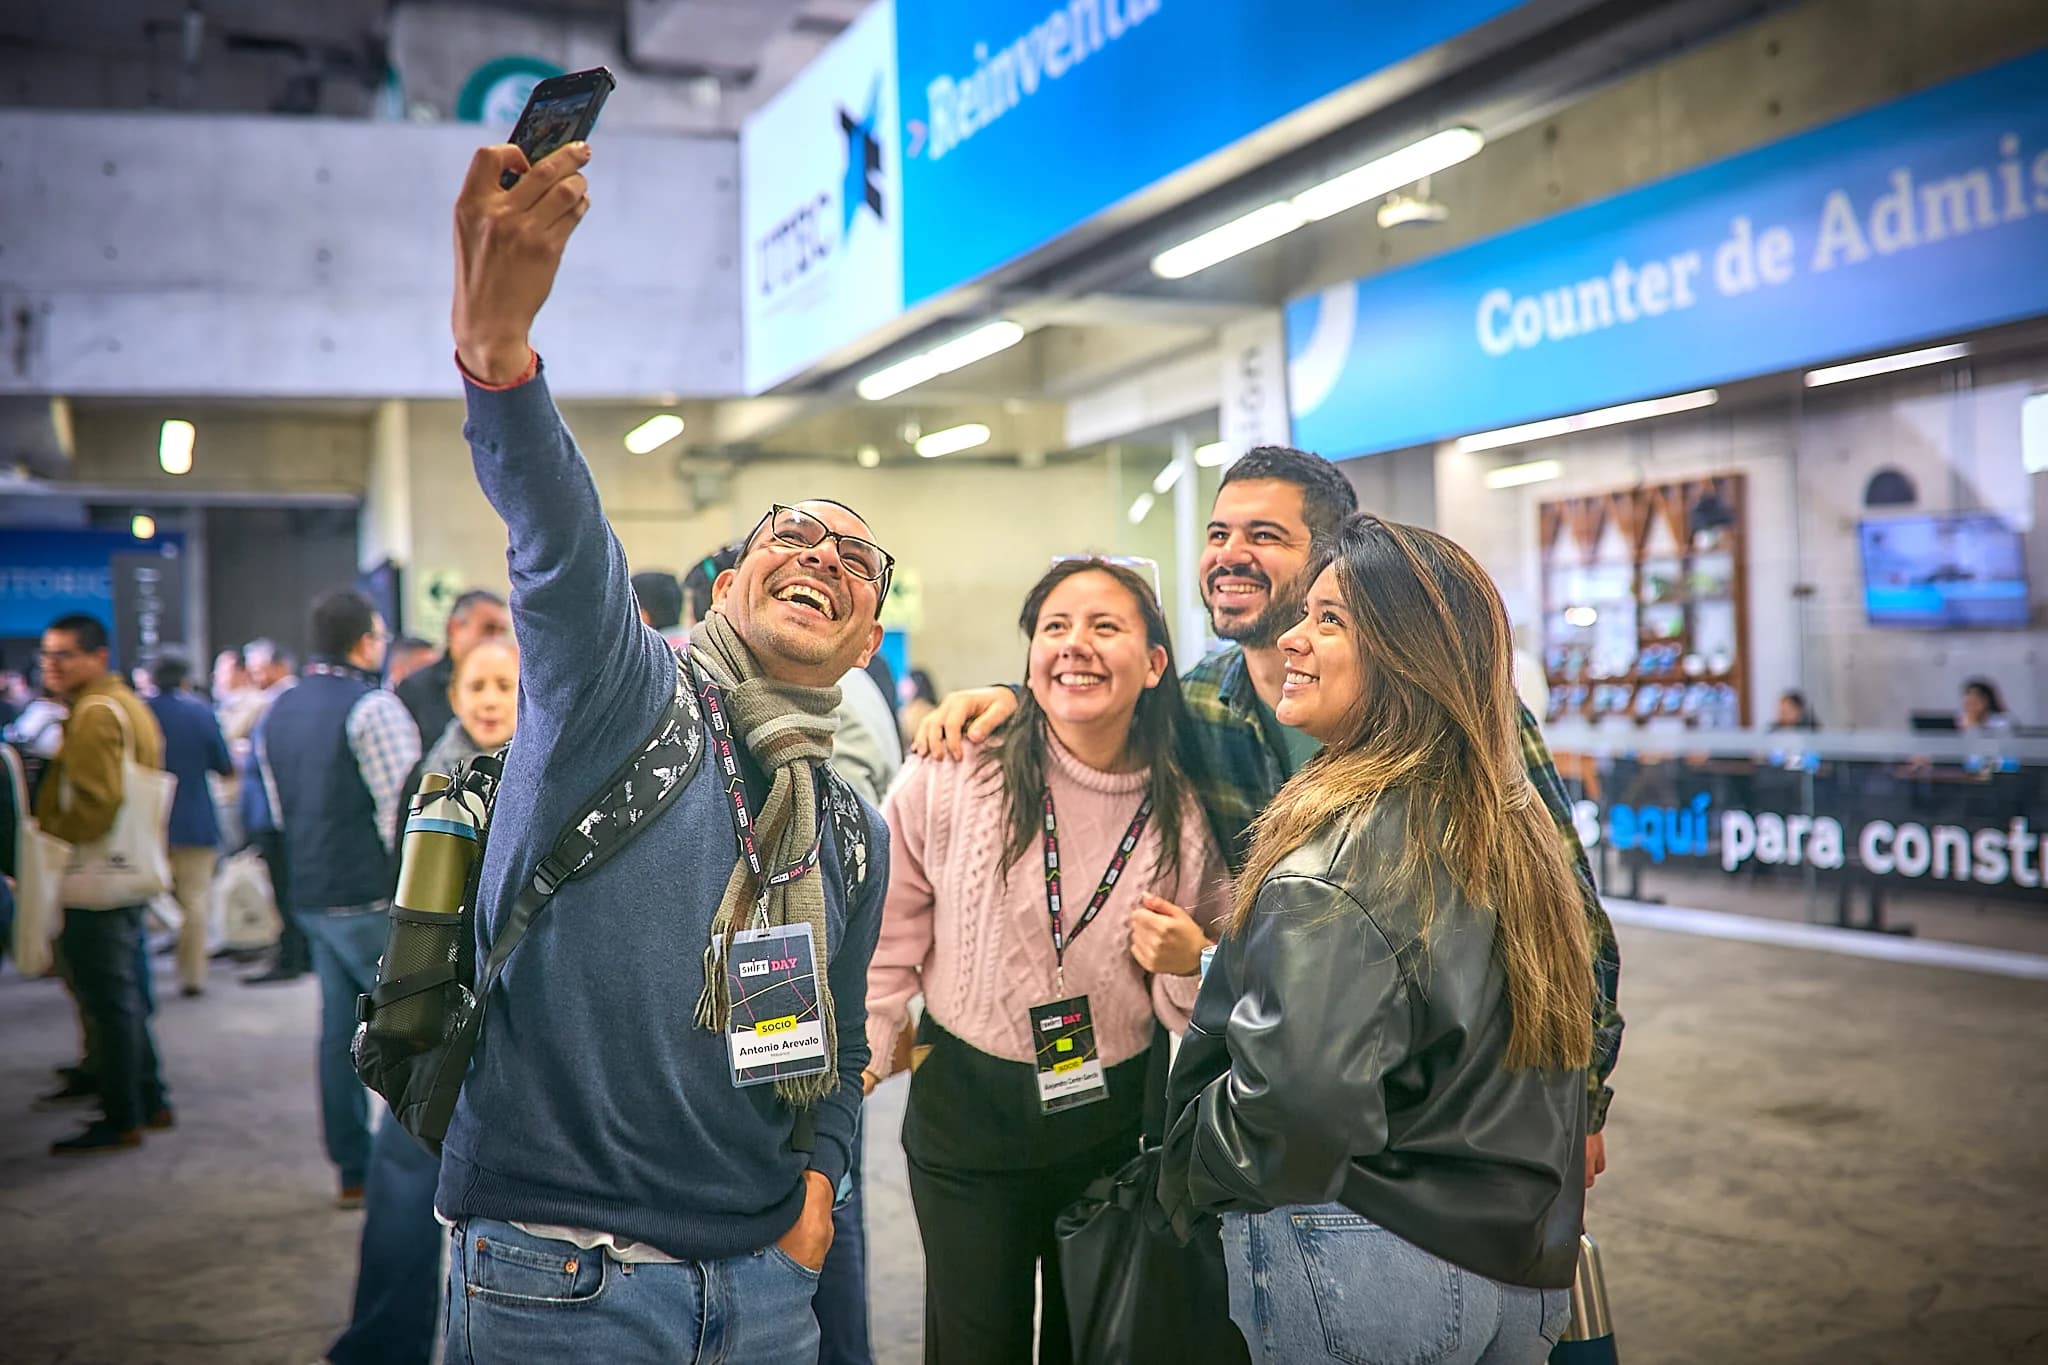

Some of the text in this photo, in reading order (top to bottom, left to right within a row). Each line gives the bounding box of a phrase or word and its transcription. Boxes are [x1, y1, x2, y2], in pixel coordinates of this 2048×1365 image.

[1476, 251, 1702, 356] Counter
[1714, 216, 1797, 297] de
[1721, 810, 1845, 873] para
[790, 866, 804, 878] DAY
[740, 957, 798, 975] SHIFT DAY
[762, 1020, 792, 1032] SOCIO
[739, 1042, 779, 1057] Antonio
[782, 1036, 819, 1050] Arevalo
